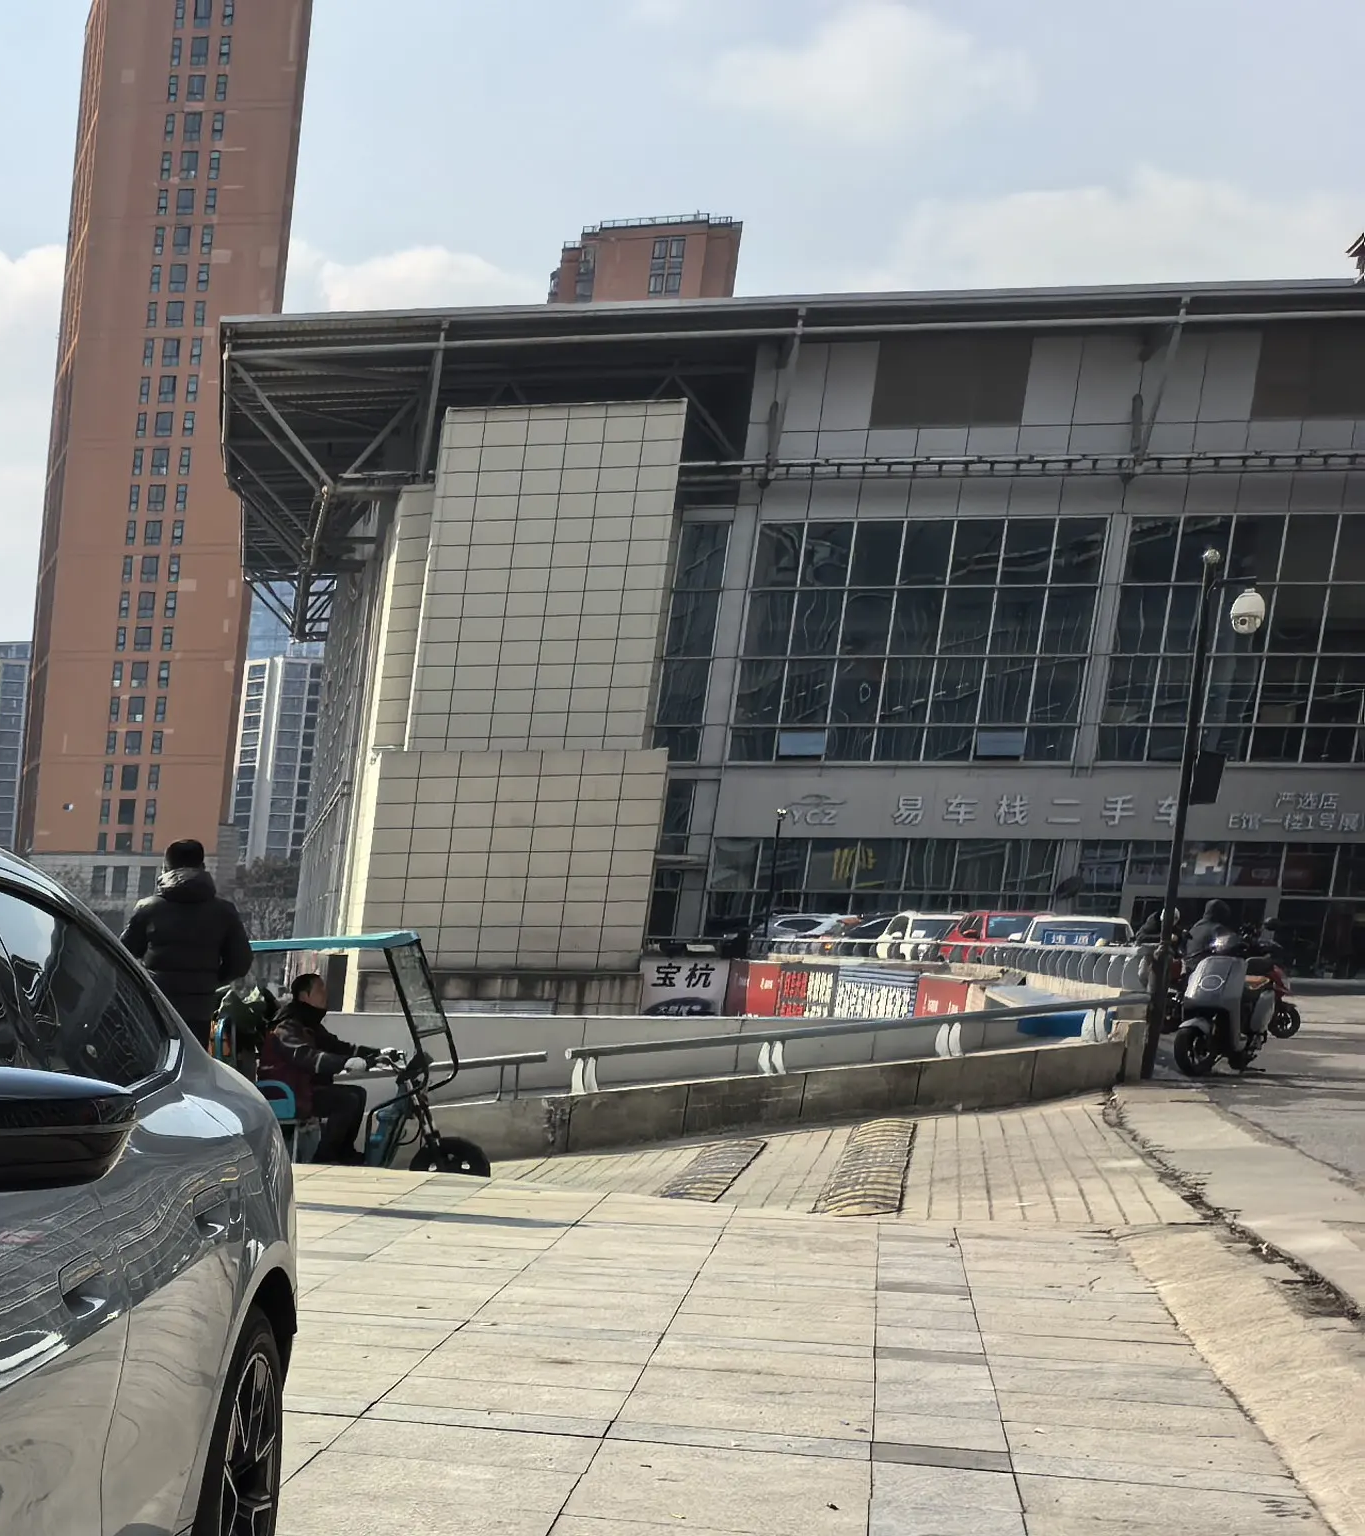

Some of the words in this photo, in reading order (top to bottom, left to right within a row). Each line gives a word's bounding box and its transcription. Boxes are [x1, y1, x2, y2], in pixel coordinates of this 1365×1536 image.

[1227, 812, 1365, 832] E馆一楼1号展
[651, 962, 716, 988] 宝杭
